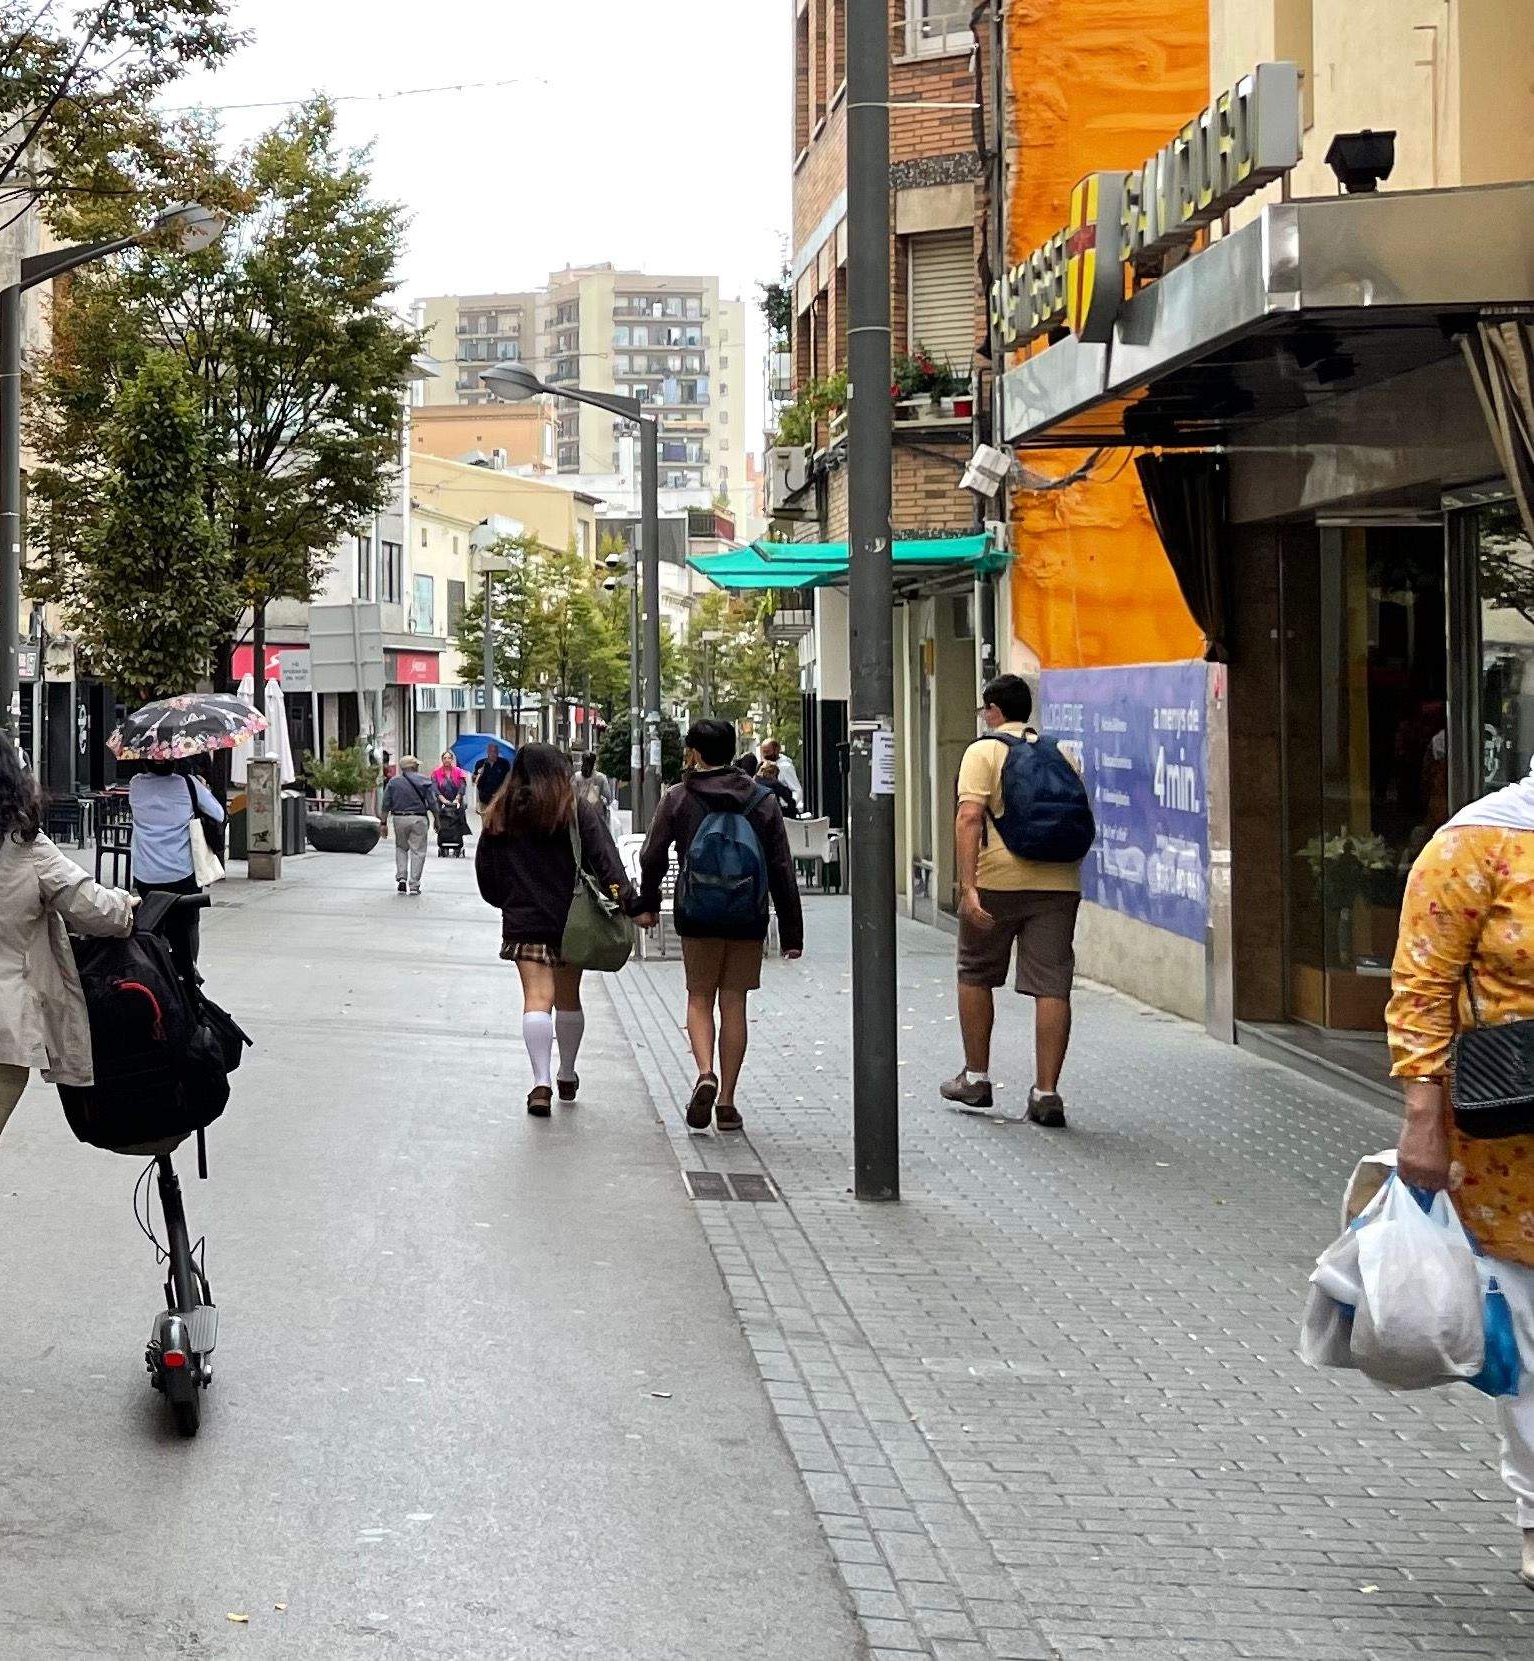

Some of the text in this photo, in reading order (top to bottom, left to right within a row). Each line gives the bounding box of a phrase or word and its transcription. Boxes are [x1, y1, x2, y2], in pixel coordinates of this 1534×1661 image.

[1153, 708, 1159, 730] a
[1159, 708, 1187, 740] menys
[1188, 700, 1199, 732] de
[1153, 745, 1165, 807] 4
[1166, 747, 1201, 814] min.
